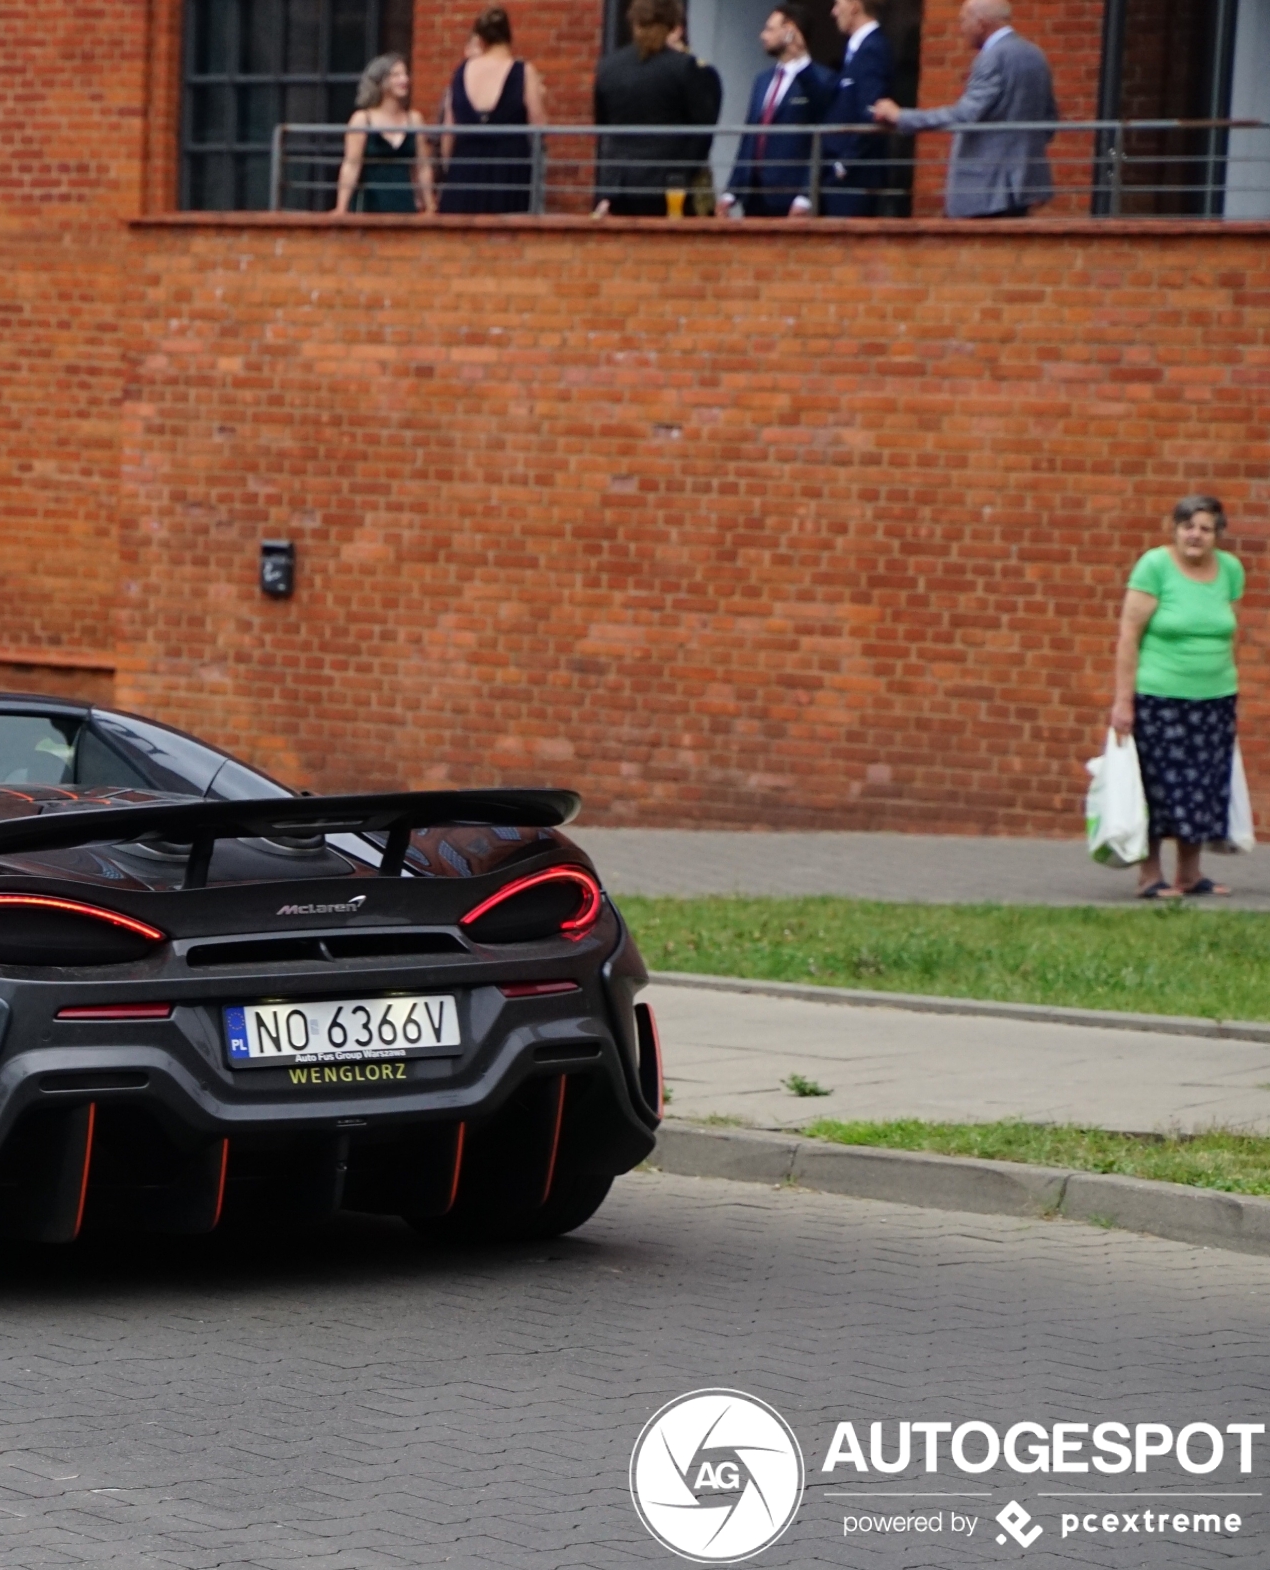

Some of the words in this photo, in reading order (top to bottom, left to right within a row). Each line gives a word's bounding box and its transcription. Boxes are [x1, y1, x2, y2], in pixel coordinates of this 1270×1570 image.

[276, 903, 357, 915] McLaren
[255, 1009, 310, 1053] NO
[327, 1001, 444, 1048] 6366V
[232, 1039, 247, 1050] PL
[295, 1053, 317, 1062] Auto
[336, 1050, 362, 1062] Group
[363, 1050, 406, 1058] Warszawa
[289, 1063, 407, 1084] WENGLORZ
